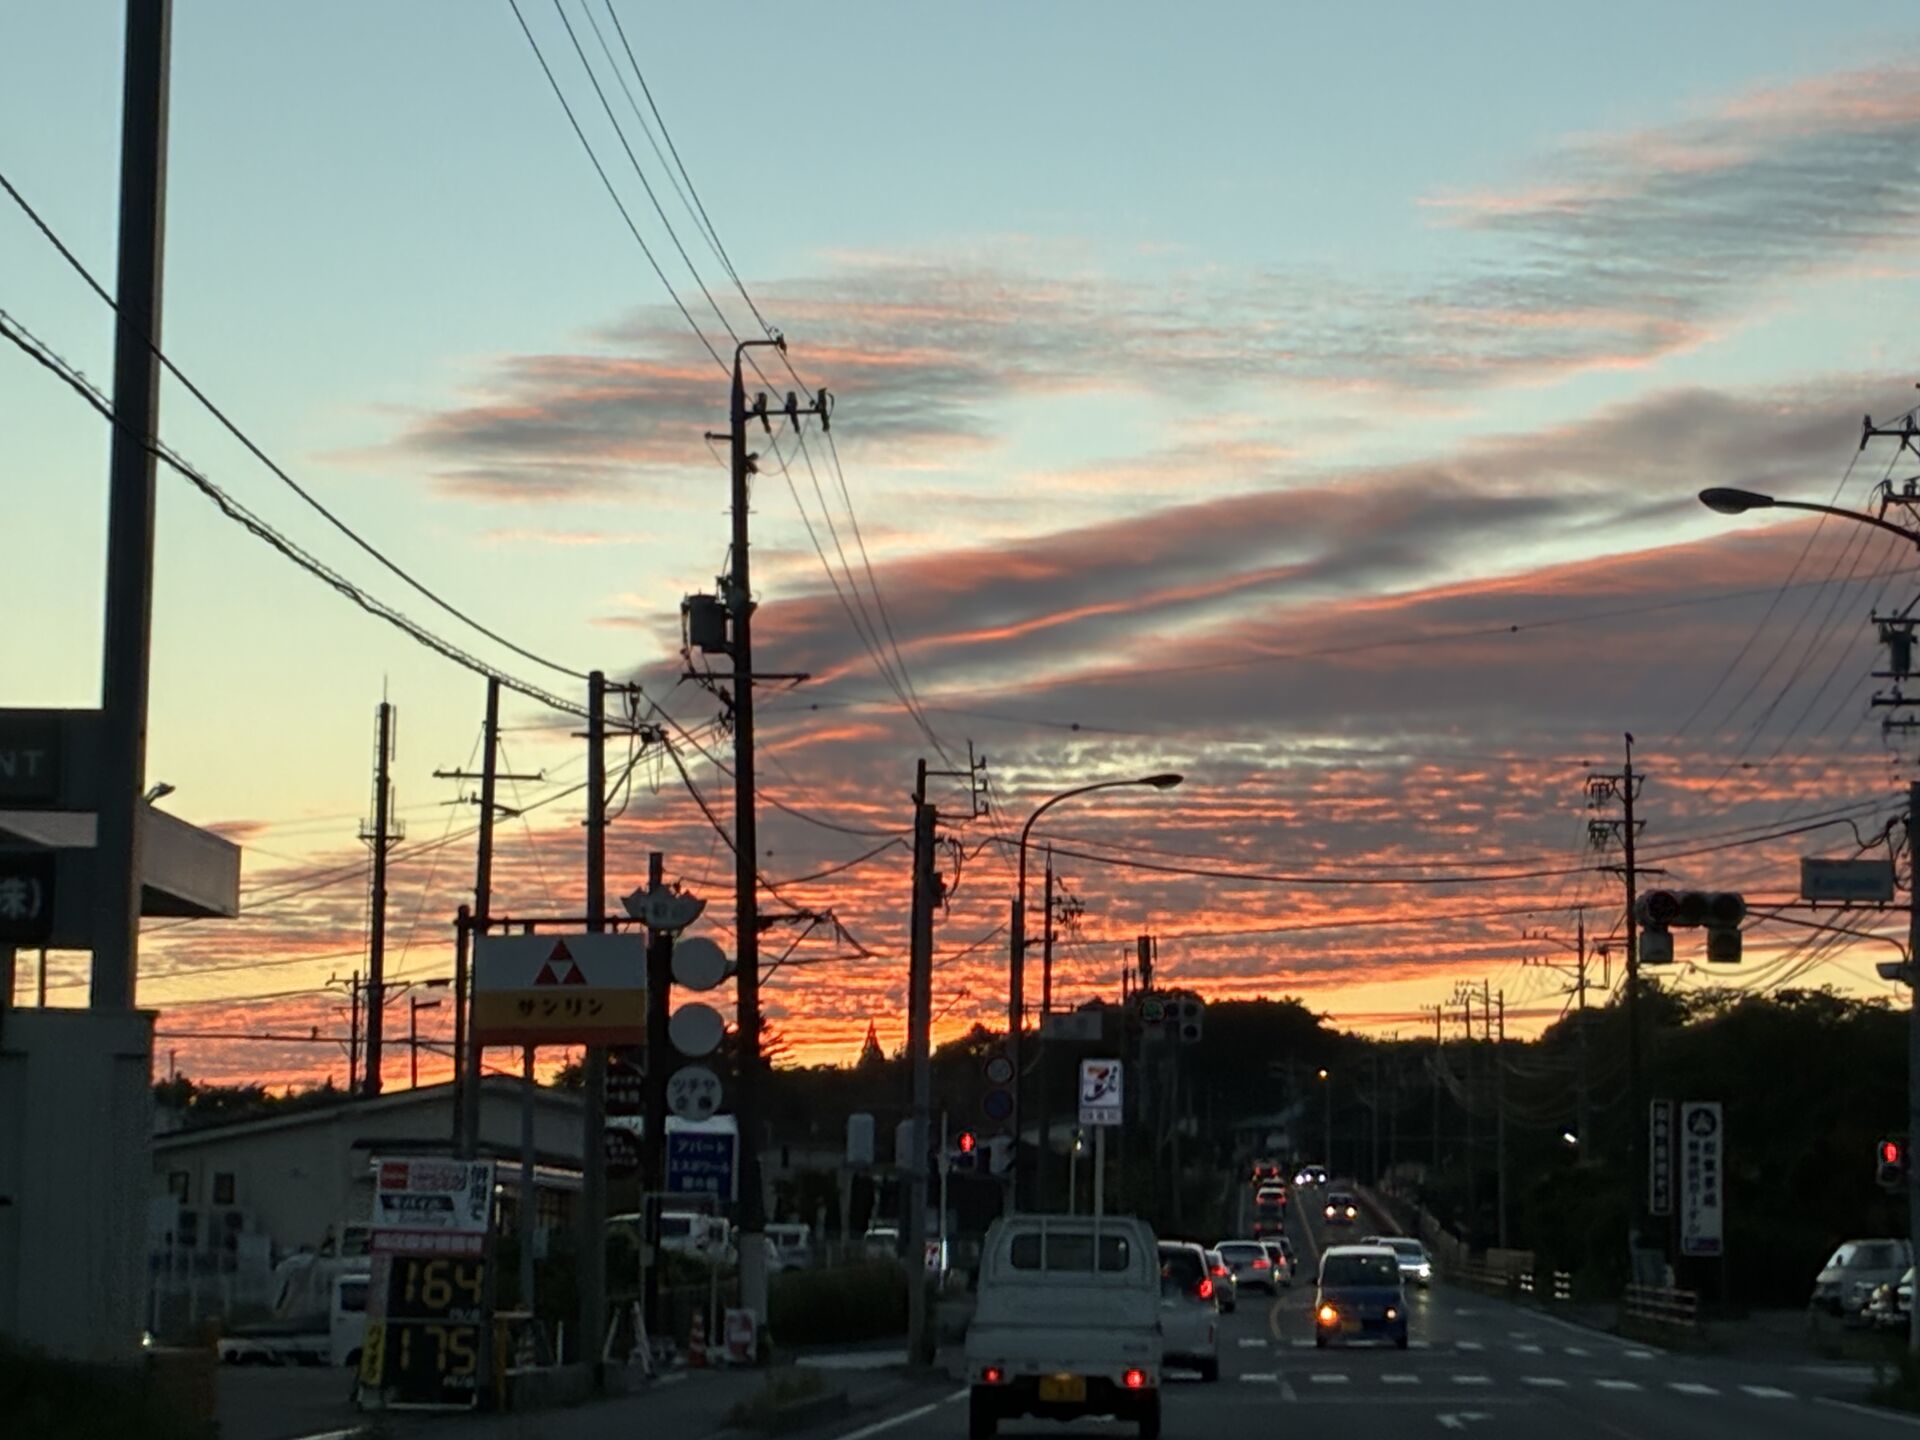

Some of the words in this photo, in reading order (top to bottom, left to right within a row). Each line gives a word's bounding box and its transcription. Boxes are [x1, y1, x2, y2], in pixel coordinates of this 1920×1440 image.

[517, 998, 605, 1017] サンリン
[677, 1139, 727, 1155] アパート
[404, 1260, 485, 1309] 164
[399, 1325, 477, 1376] 175
